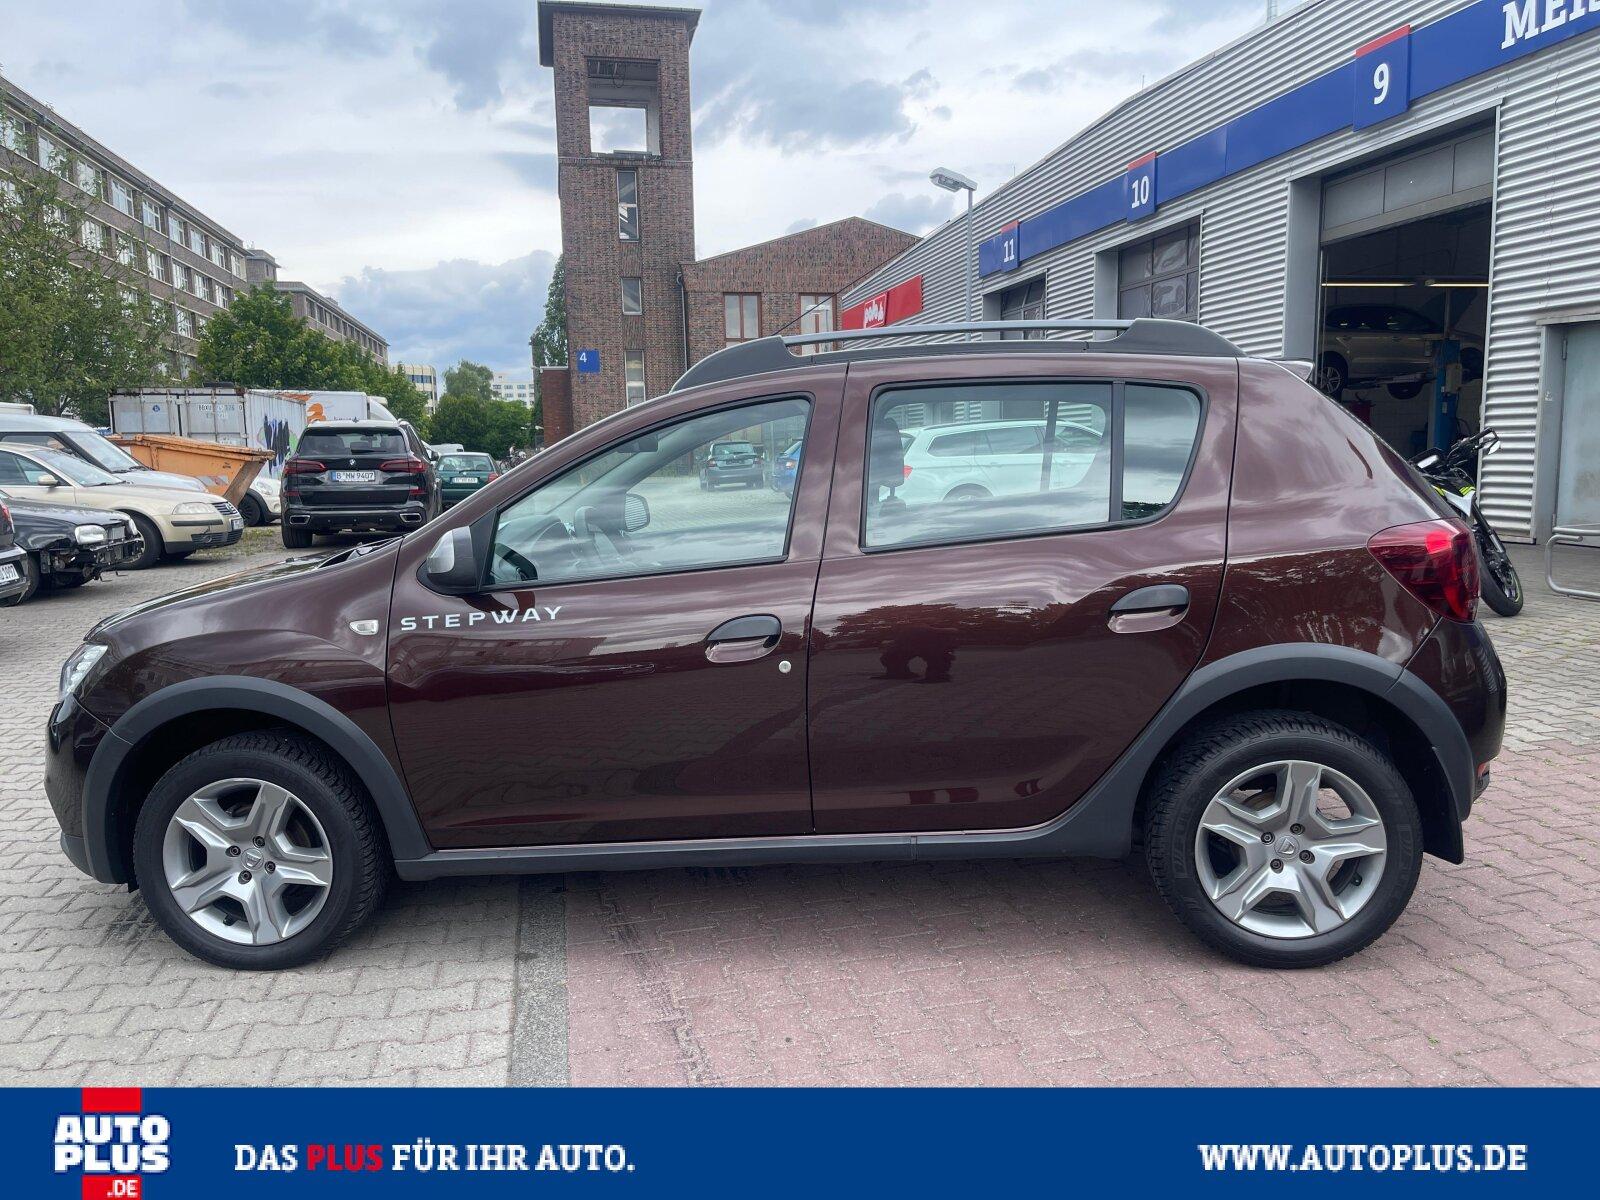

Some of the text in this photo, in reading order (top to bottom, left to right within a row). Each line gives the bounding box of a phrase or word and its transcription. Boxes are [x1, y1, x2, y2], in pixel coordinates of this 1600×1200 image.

[1501, 0, 1600, 49] ME
[1373, 63, 1389, 105] 9
[1131, 175, 1149, 208] 10
[1003, 238, 1014, 263] 11
[580, 352, 587, 363] 4
[400, 605, 563, 631] STEPWAY
